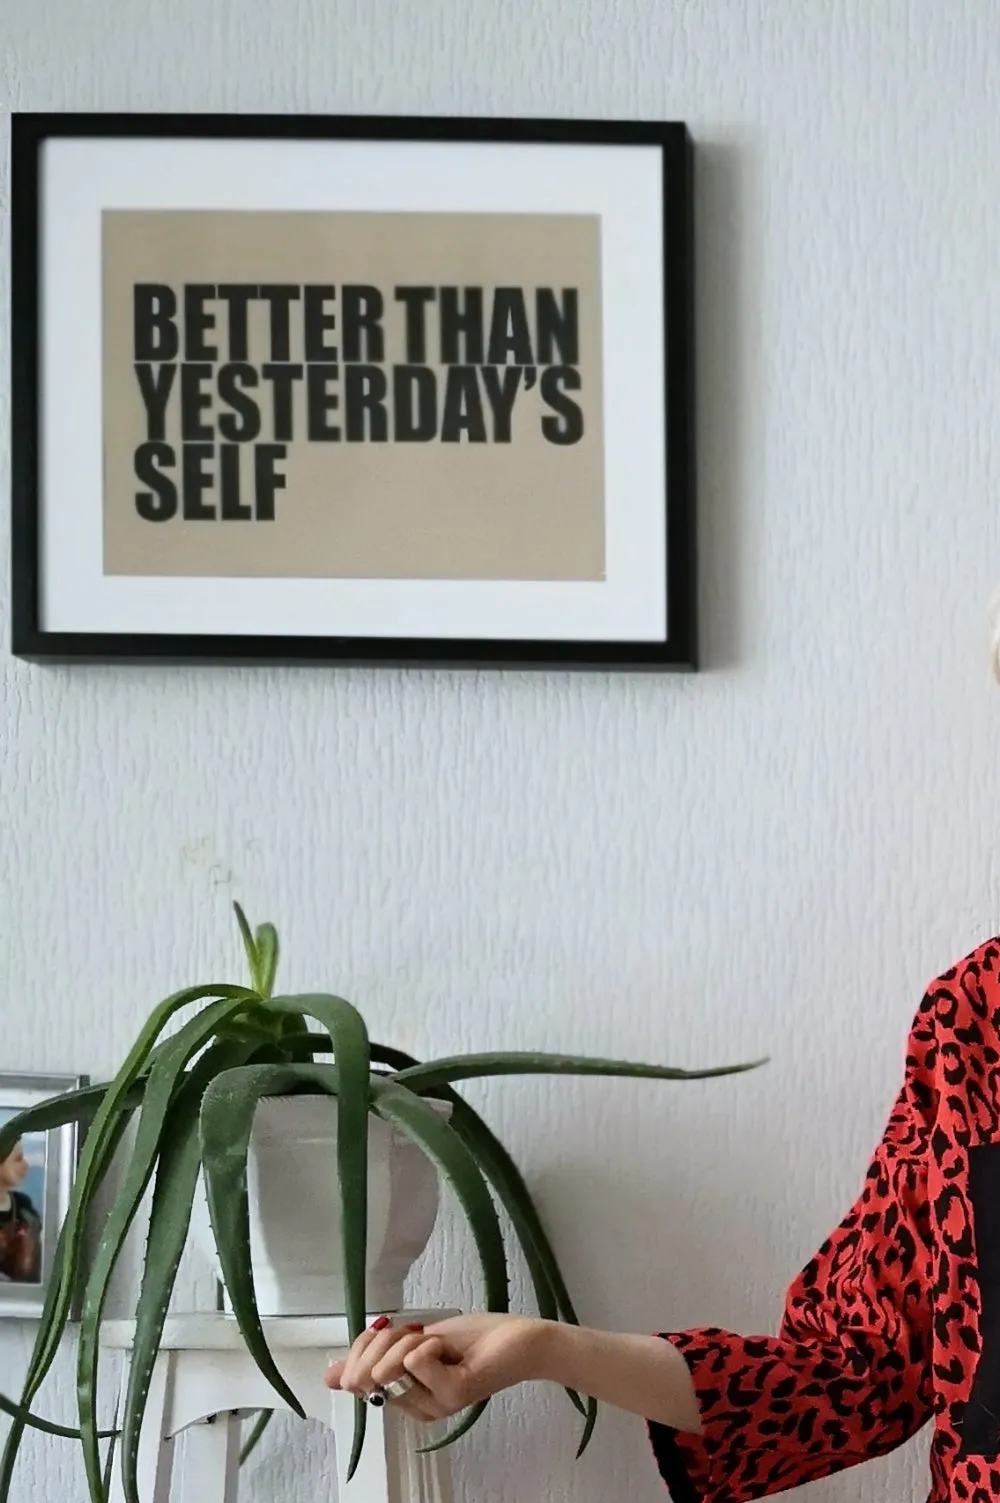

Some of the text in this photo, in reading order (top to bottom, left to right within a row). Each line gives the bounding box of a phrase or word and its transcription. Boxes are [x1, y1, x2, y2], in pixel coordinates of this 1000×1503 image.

[133, 283, 580, 365] BETTER THAN
[133, 362, 585, 446] YESTERDAY'S
[133, 442, 288, 522] SELF
